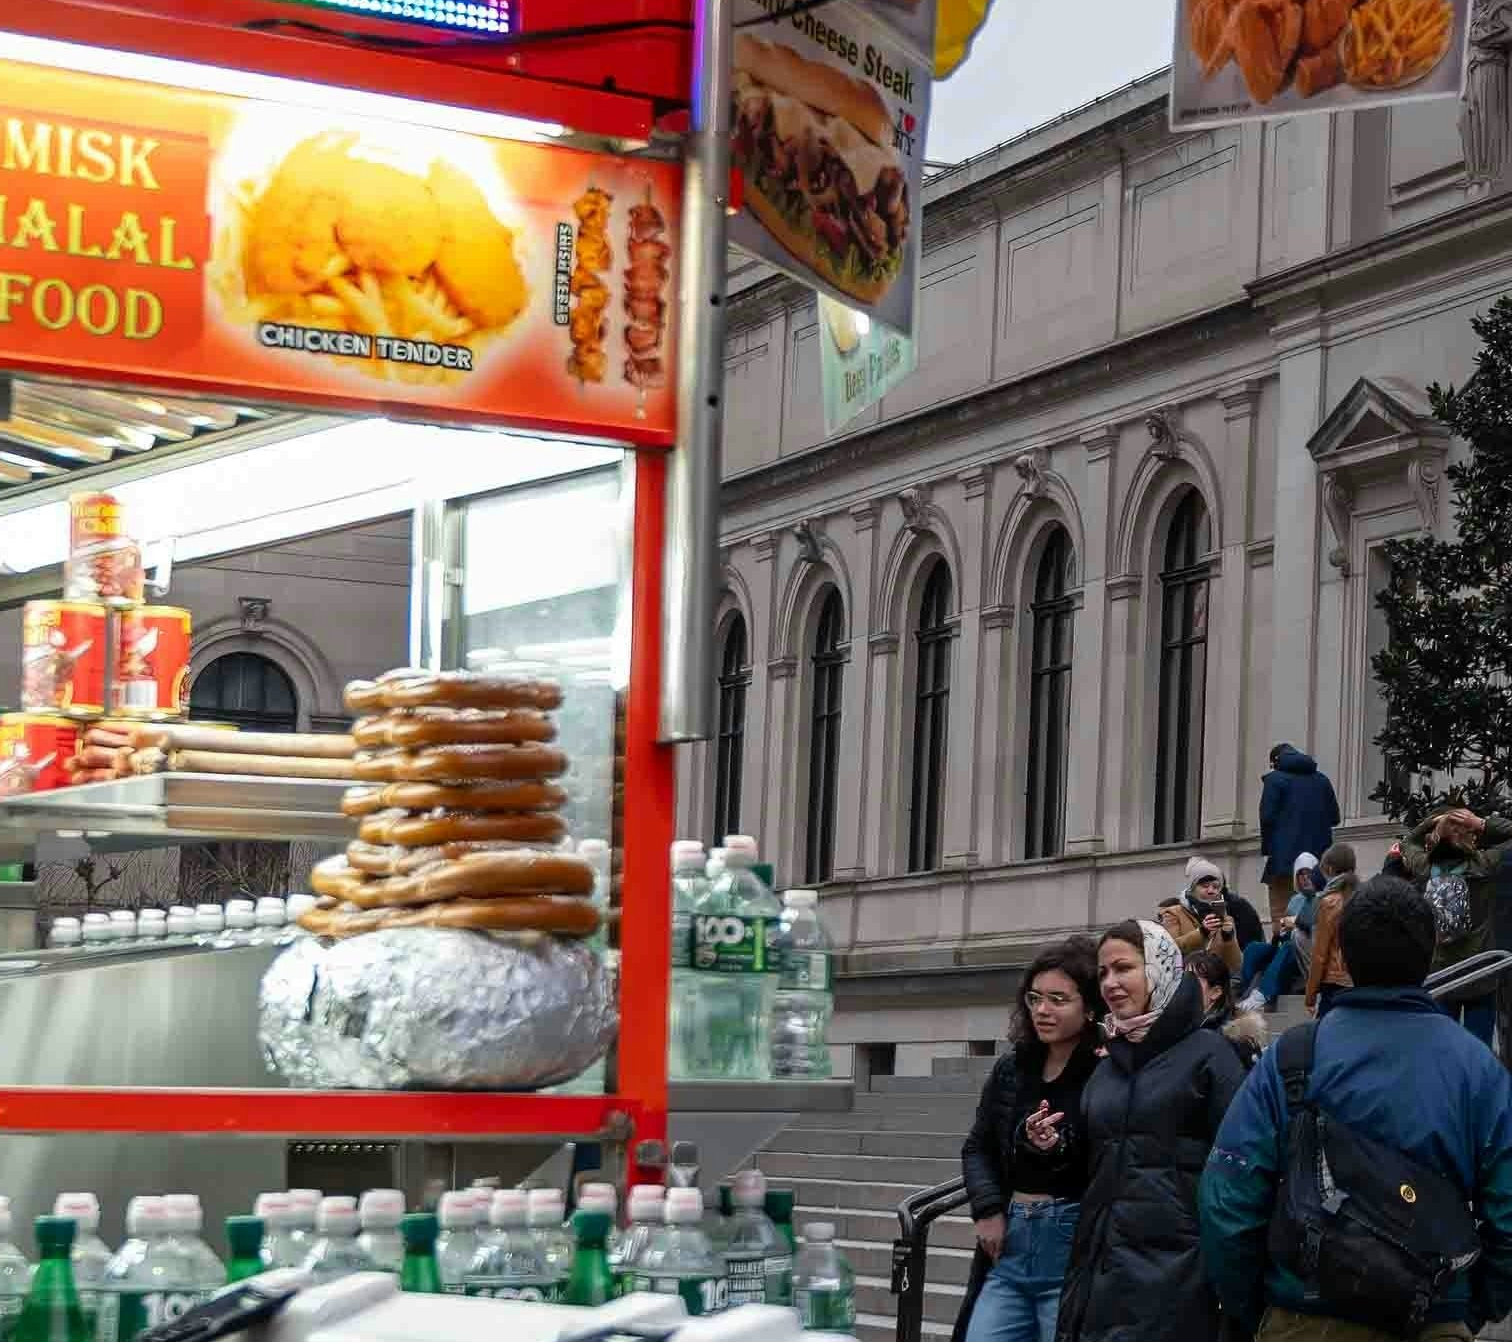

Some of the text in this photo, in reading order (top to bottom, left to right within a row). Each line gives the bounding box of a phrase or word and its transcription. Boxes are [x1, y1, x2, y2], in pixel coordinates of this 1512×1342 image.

[863, 43, 915, 104] Steak
[2, 118, 162, 190] MISK
[258, 324, 474, 371] CHICKEN TENDER
